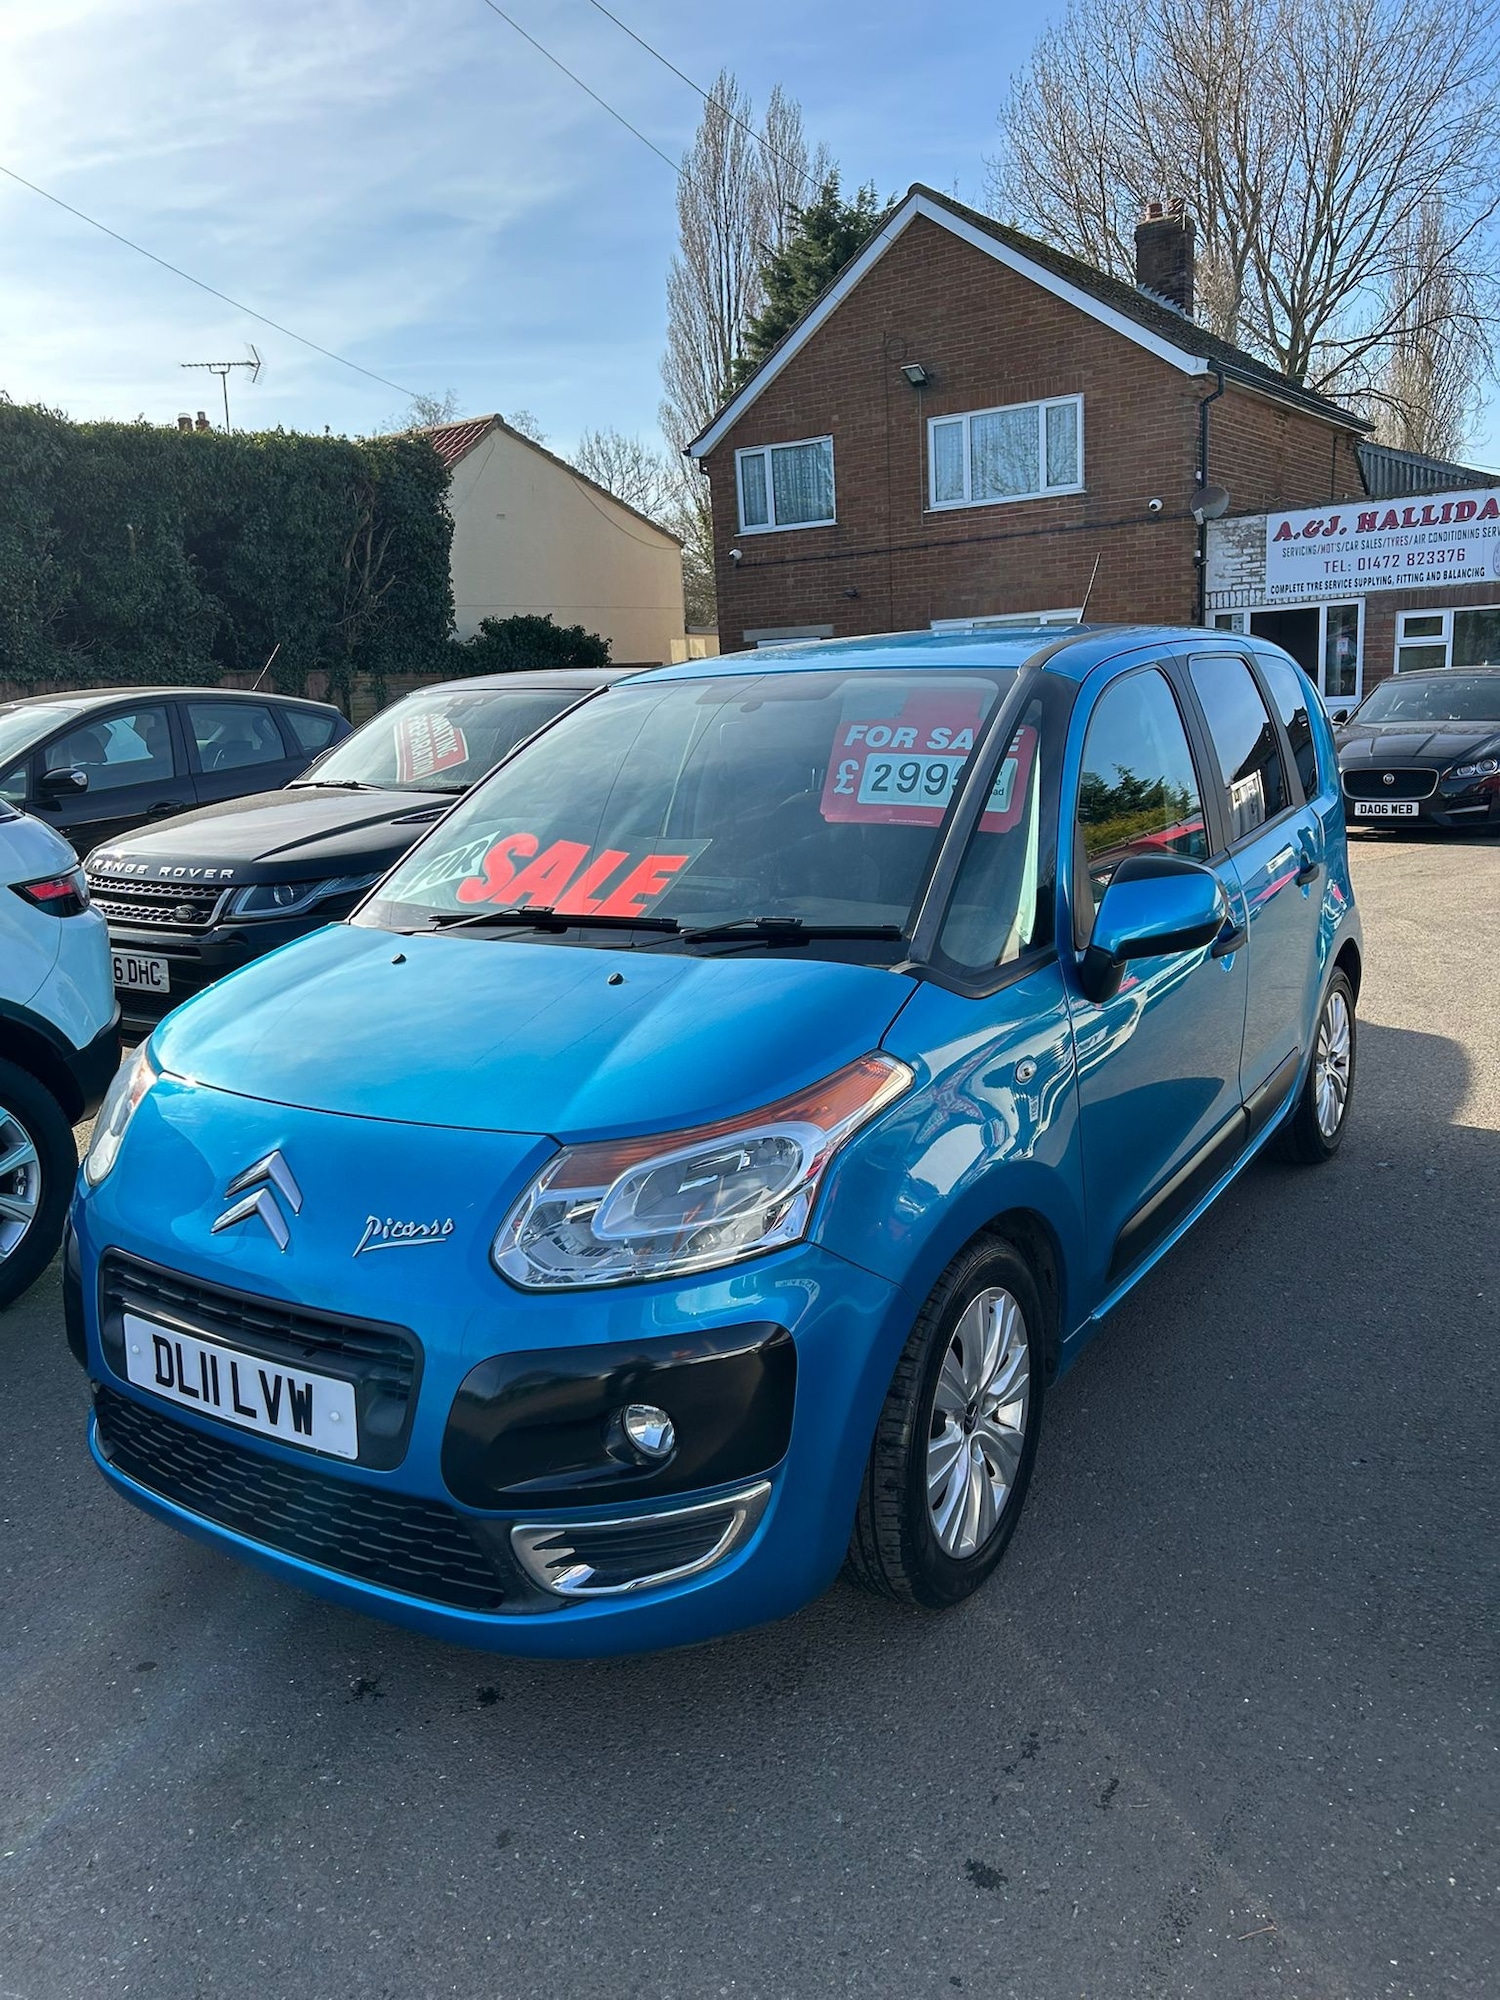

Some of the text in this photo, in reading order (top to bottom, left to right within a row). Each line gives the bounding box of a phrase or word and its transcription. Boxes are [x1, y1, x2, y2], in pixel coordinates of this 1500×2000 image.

[1428, 528, 1480, 543] CONDITIONING
[1324, 548, 1466, 573] TEL: 01472 823376
[1270, 566, 1485, 595] COMPLETE TYRE SERVICE SUPPLYING, FITTING AND BALANCING
[843, 725, 1025, 752] FOR SA
[871, 762, 965, 797] 299
[1360, 804, 1389, 815] DA06
[92, 859, 234, 879] RANGE ROVER
[402, 832, 690, 918] FOR SALE
[127, 958, 161, 986] DHC
[152, 1333, 313, 1437] DL11 LVW
